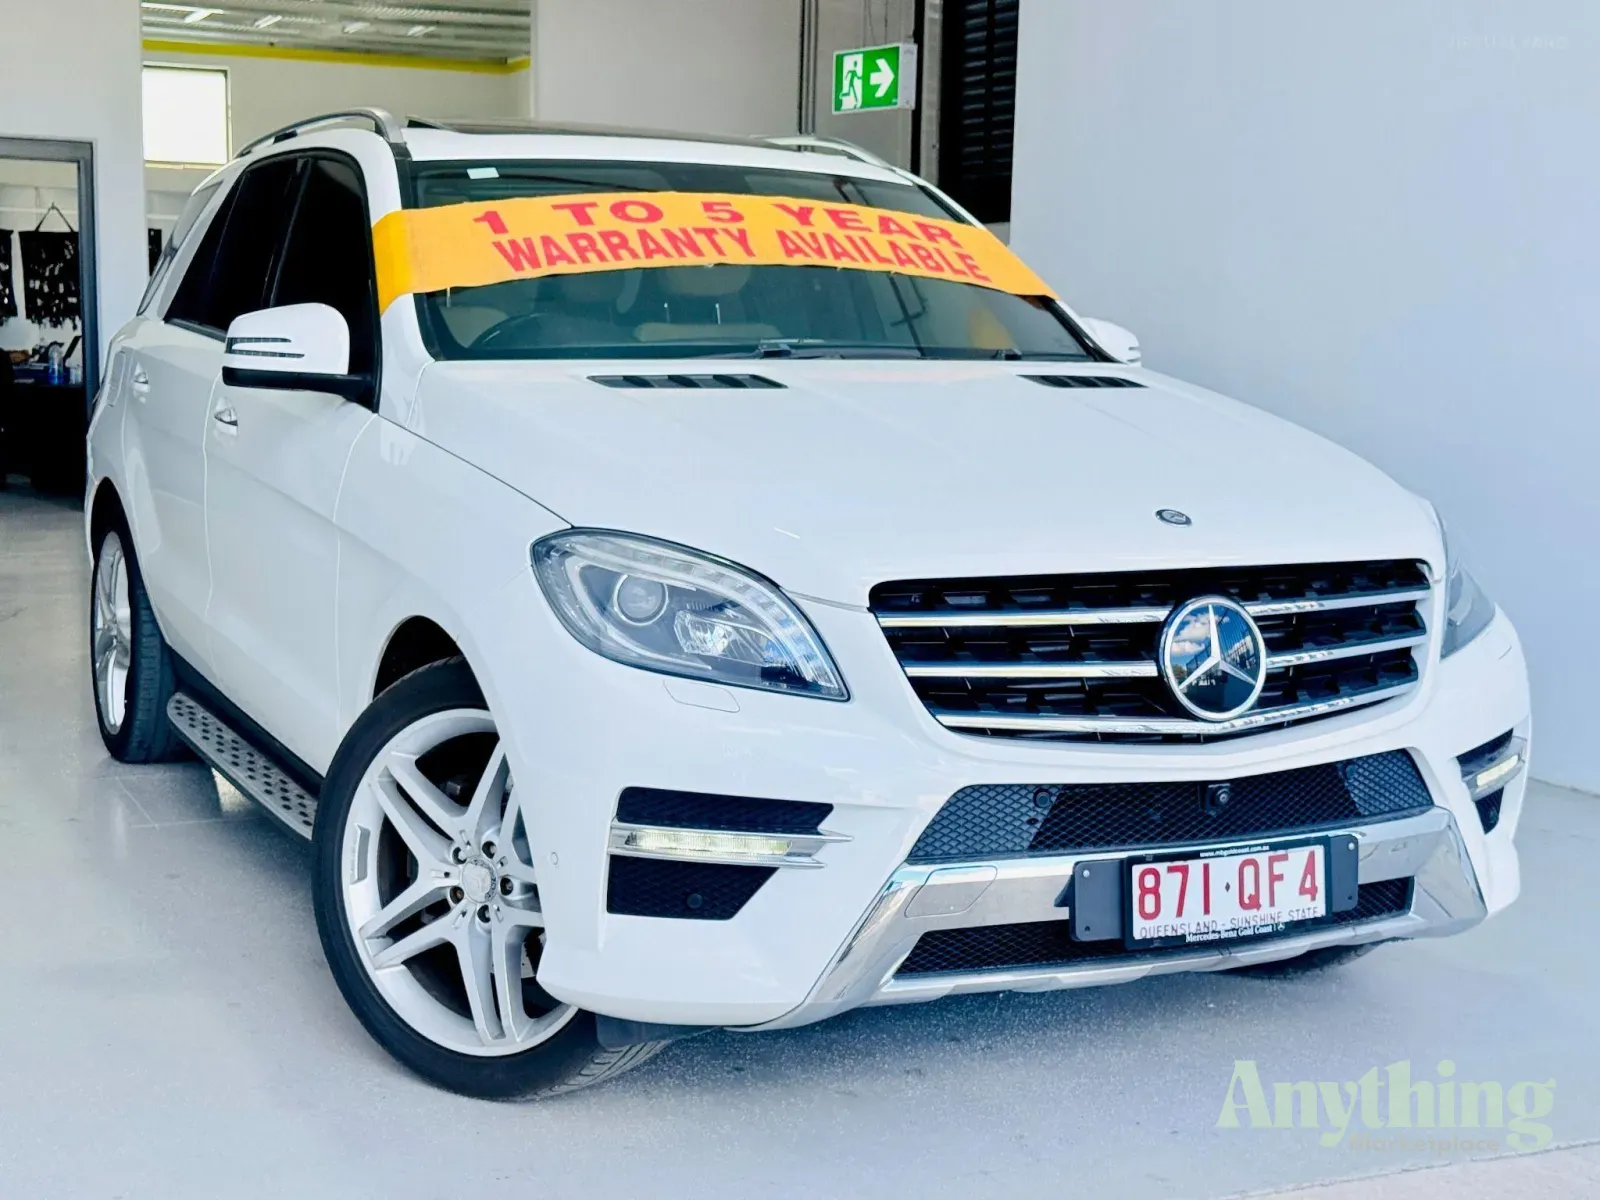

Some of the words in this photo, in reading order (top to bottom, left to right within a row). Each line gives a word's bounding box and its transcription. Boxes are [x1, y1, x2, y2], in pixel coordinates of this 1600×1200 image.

[473, 211, 508, 234] 1
[551, 200, 664, 226] TO
[701, 202, 745, 223] 5
[771, 203, 964, 249] YEAR
[492, 227, 756, 272] WARRANTY
[776, 229, 993, 282] AVAILABLE
[1140, 918, 1218, 938] QUEENSLAND
[1230, 911, 1282, 928] SUNSHINE
[1288, 906, 1318, 919] STATE
